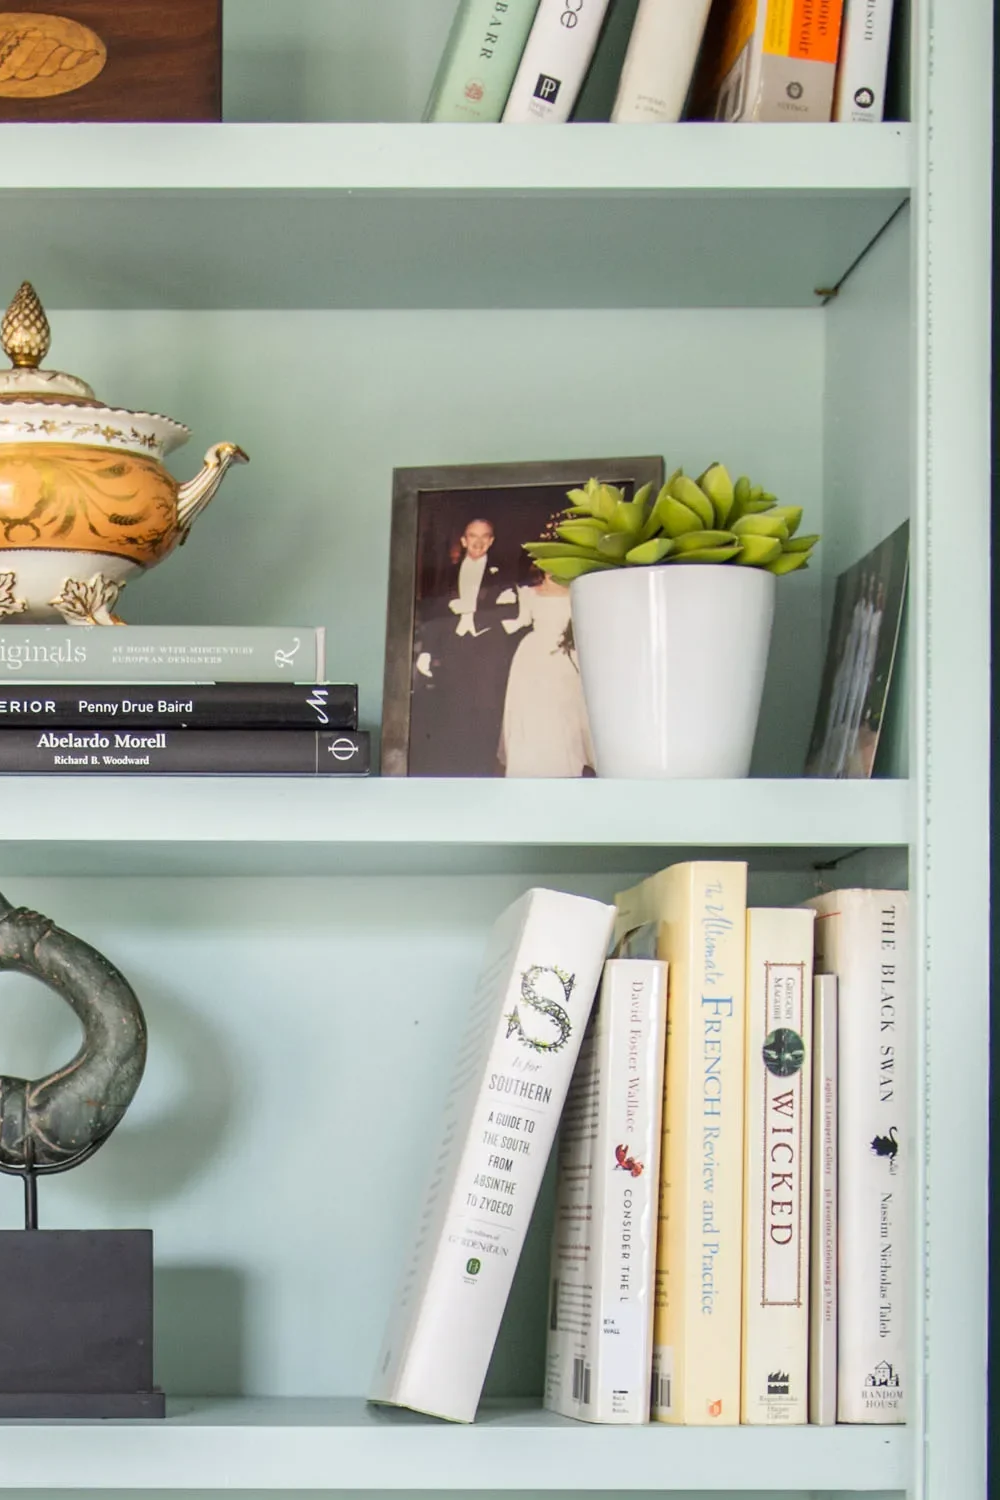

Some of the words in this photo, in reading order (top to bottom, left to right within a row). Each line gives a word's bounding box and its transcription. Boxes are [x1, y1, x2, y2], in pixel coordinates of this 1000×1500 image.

[78, 700, 116, 717] Penny
[121, 700, 154, 713] Drue
[159, 700, 193, 714] Baird
[38, 733, 110, 748] Abelardo
[114, 733, 165, 748] Morell
[54, 755, 88, 765] Richard
[92, 755, 100, 765] B.
[102, 755, 149, 765] Woodward
[703, 904, 733, 984] Ultimate
[881, 906, 896, 951] THE
[629, 981, 644, 1024] David
[773, 977, 783, 1020] MAGUIRE
[784, 977, 794, 1020] GREGORY
[880, 964, 895, 1032] BLACK
[628, 1029, 643, 1071] Foster
[702, 994, 733, 1116] FRENCH
[489, 1073, 552, 1104] SOUTHERN
[879, 1046, 894, 1102] SWAN
[625, 1077, 640, 1133] Wallace
[488, 1155, 512, 1172] FROM
[702, 1126, 720, 1193] Review
[771, 1090, 794, 1246] WICKED
[474, 1173, 516, 1195] ABSINTHE
[702, 1200, 719, 1234] and
[879, 1193, 893, 1238] Nassim
[701, 1243, 718, 1315] Practice
[879, 1243, 892, 1298] Nicholas
[879, 1303, 891, 1338] Taleb
[862, 1390, 903, 1399] RANDOM
[866, 1400, 898, 1408] HOUSE
